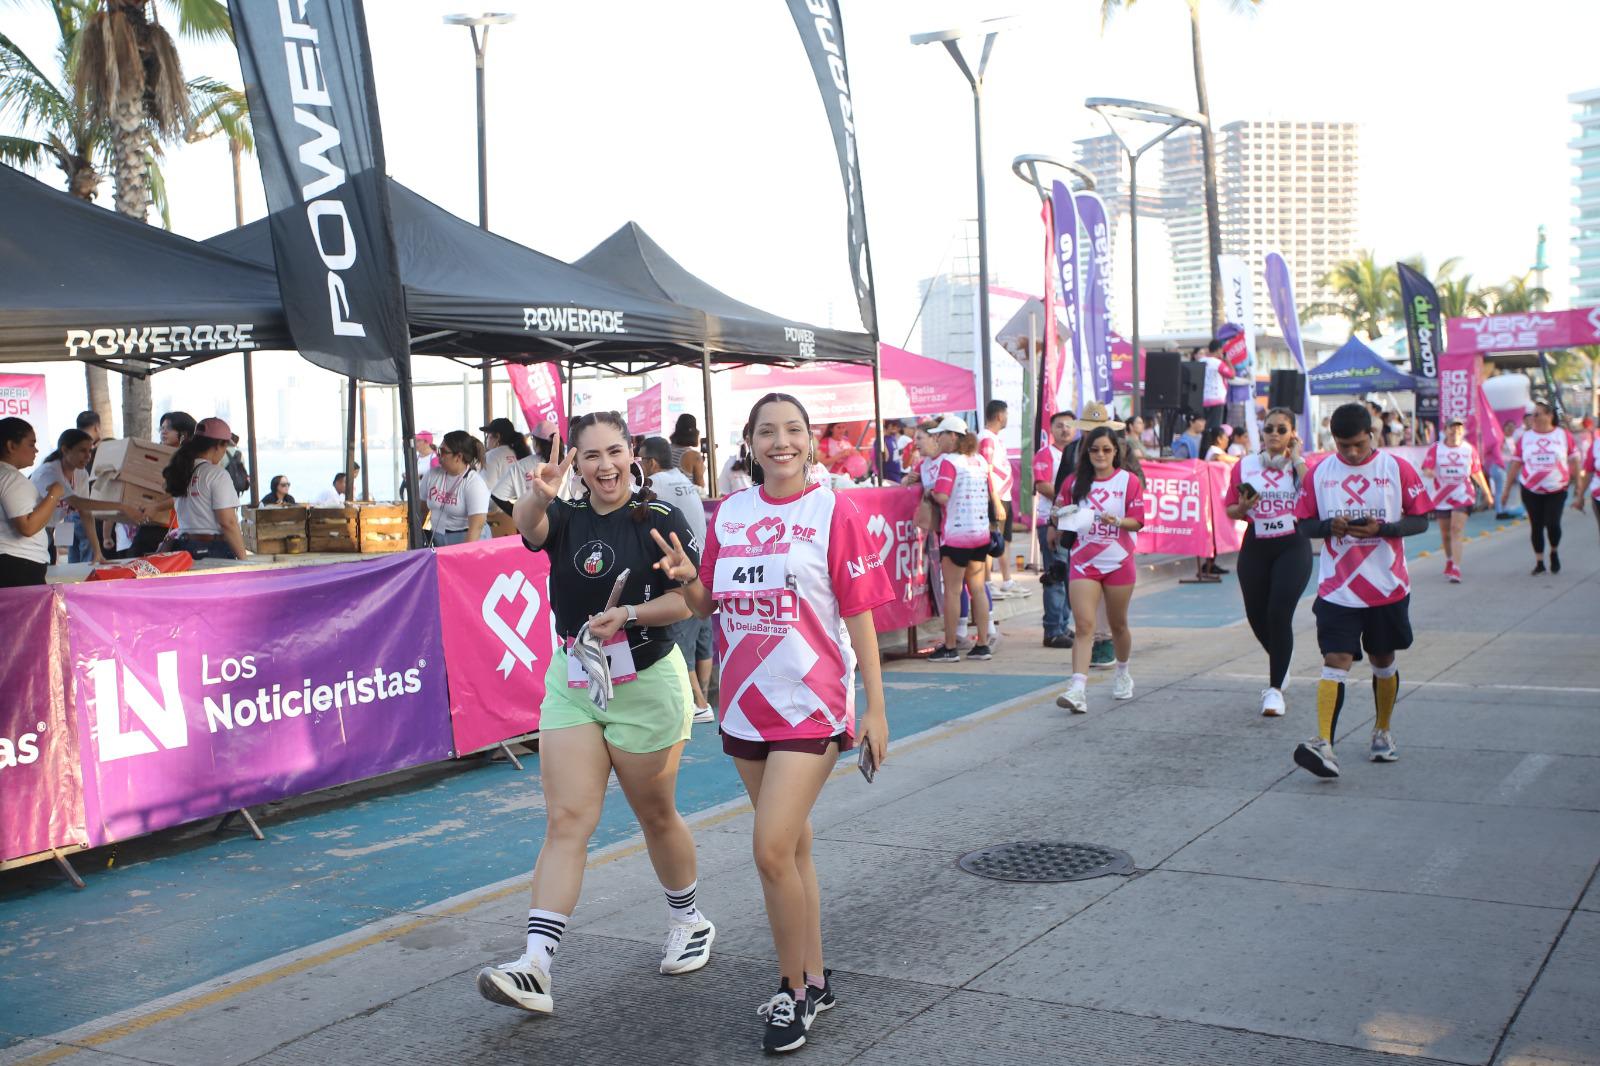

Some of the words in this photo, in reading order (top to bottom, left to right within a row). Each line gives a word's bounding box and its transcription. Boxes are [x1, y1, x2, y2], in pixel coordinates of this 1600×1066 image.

[523, 307, 626, 333] POWERADE
[65, 323, 256, 357] POWERADE
[784, 327, 816, 343] POWER
[1143, 493, 1201, 522] OSA
[791, 523, 817, 539] DIF
[1263, 520, 1284, 531] 745
[732, 565, 764, 584] 411
